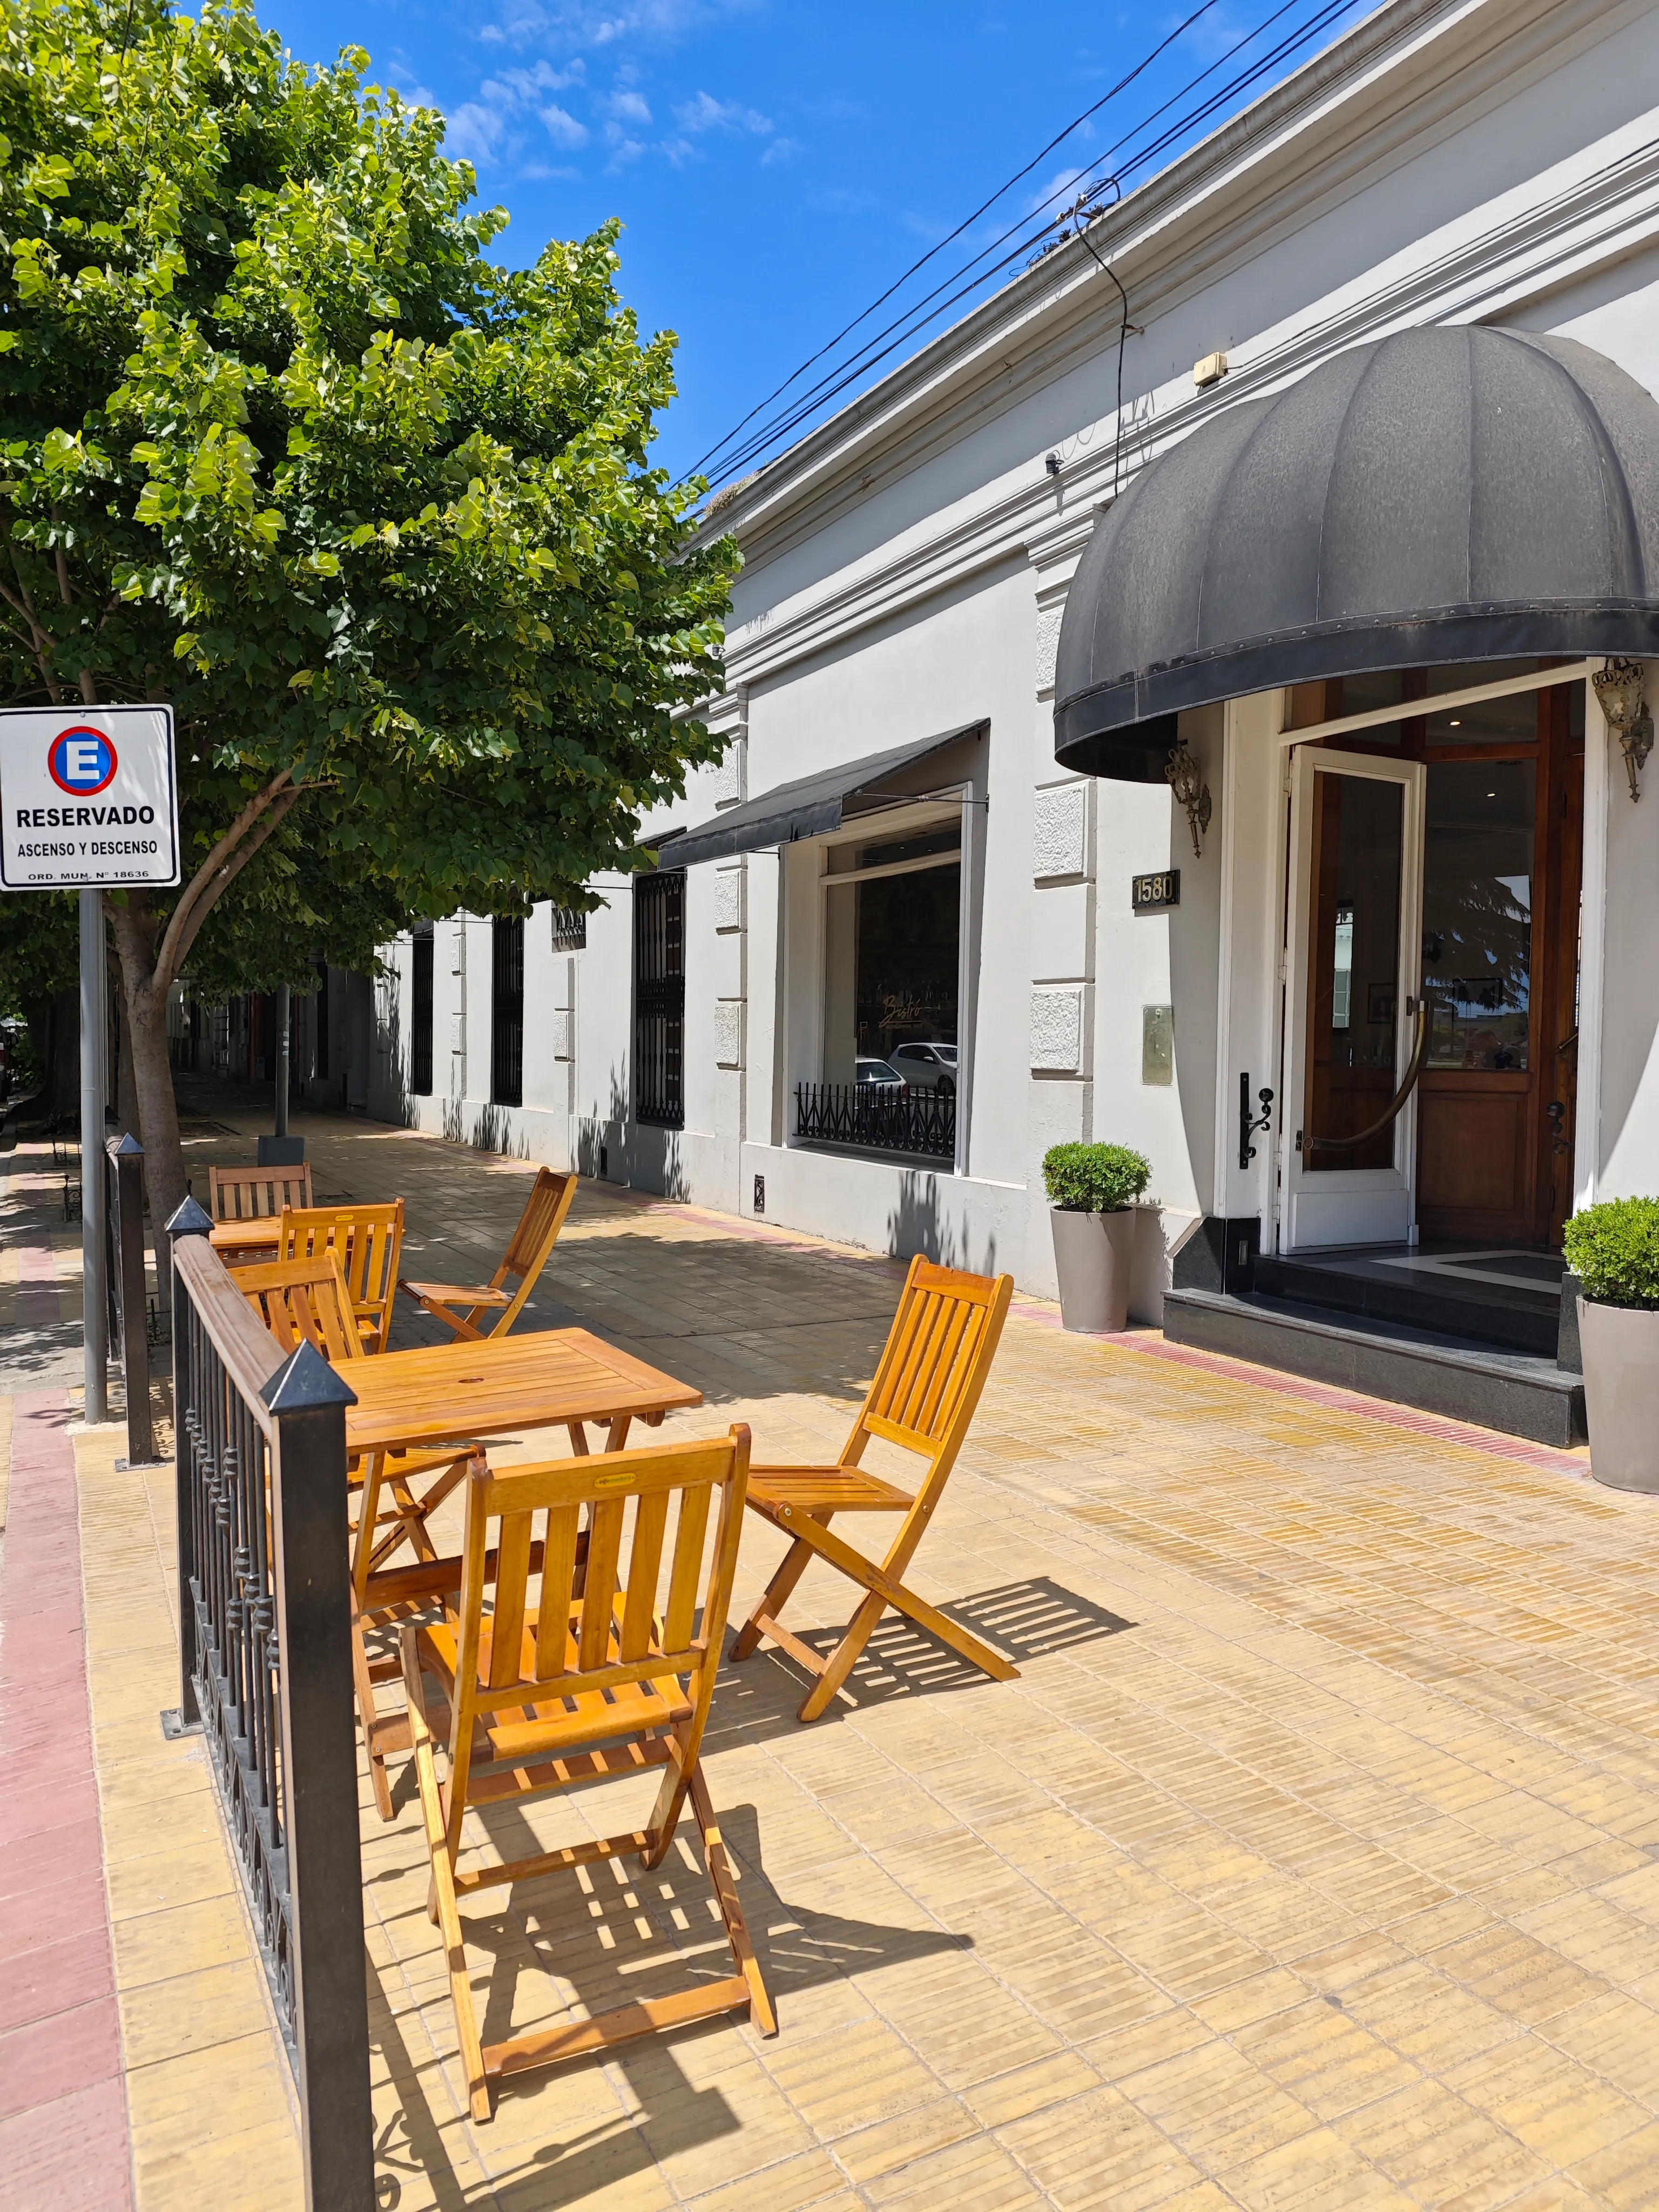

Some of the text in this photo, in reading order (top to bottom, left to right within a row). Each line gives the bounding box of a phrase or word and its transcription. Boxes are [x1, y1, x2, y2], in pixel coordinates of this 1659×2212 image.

[66, 741, 99, 779] E
[17, 806, 154, 827] RESERVADO
[18, 840, 157, 857] ASCENSO Y DESCENSO
[1136, 876, 1172, 902] 1580
[878, 994, 922, 1028] Bistró
